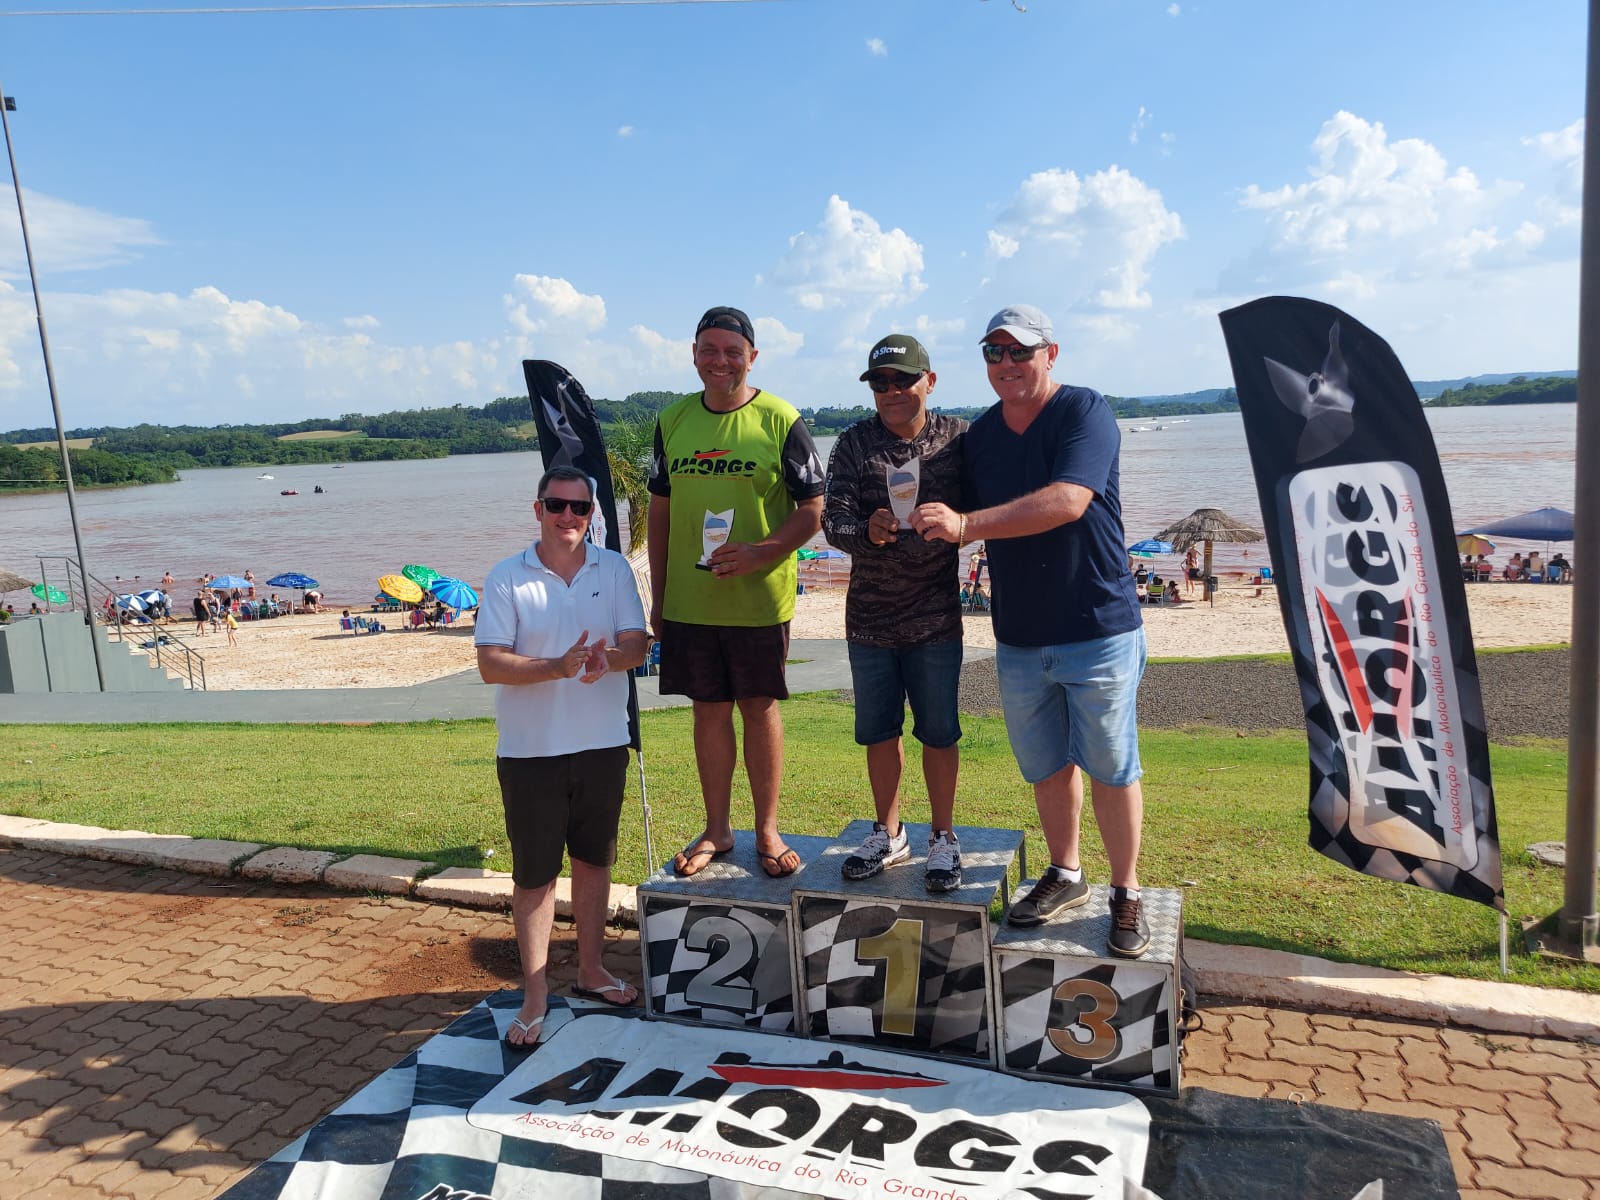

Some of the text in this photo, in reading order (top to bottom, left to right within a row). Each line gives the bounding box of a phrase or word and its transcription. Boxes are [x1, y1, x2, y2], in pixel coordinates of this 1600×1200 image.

[880, 346, 907, 355] Sicredi
[670, 457, 757, 477] AMORGS
[1335, 481, 1446, 848] AMORGS
[1400, 494, 1462, 836] Associação de Motonáutica do Rio Grande do Sul
[685, 916, 758, 1011] 2
[857, 919, 924, 1035] 1
[1048, 978, 1118, 1060] 3
[509, 1057, 1113, 1200] AMORGS
[514, 1111, 615, 1141] Associação
[626, 1131, 650, 1147] de
[660, 1138, 782, 1173] Motonáutica
[794, 1163, 821, 1179] do
[835, 1168, 867, 1187] Rio
